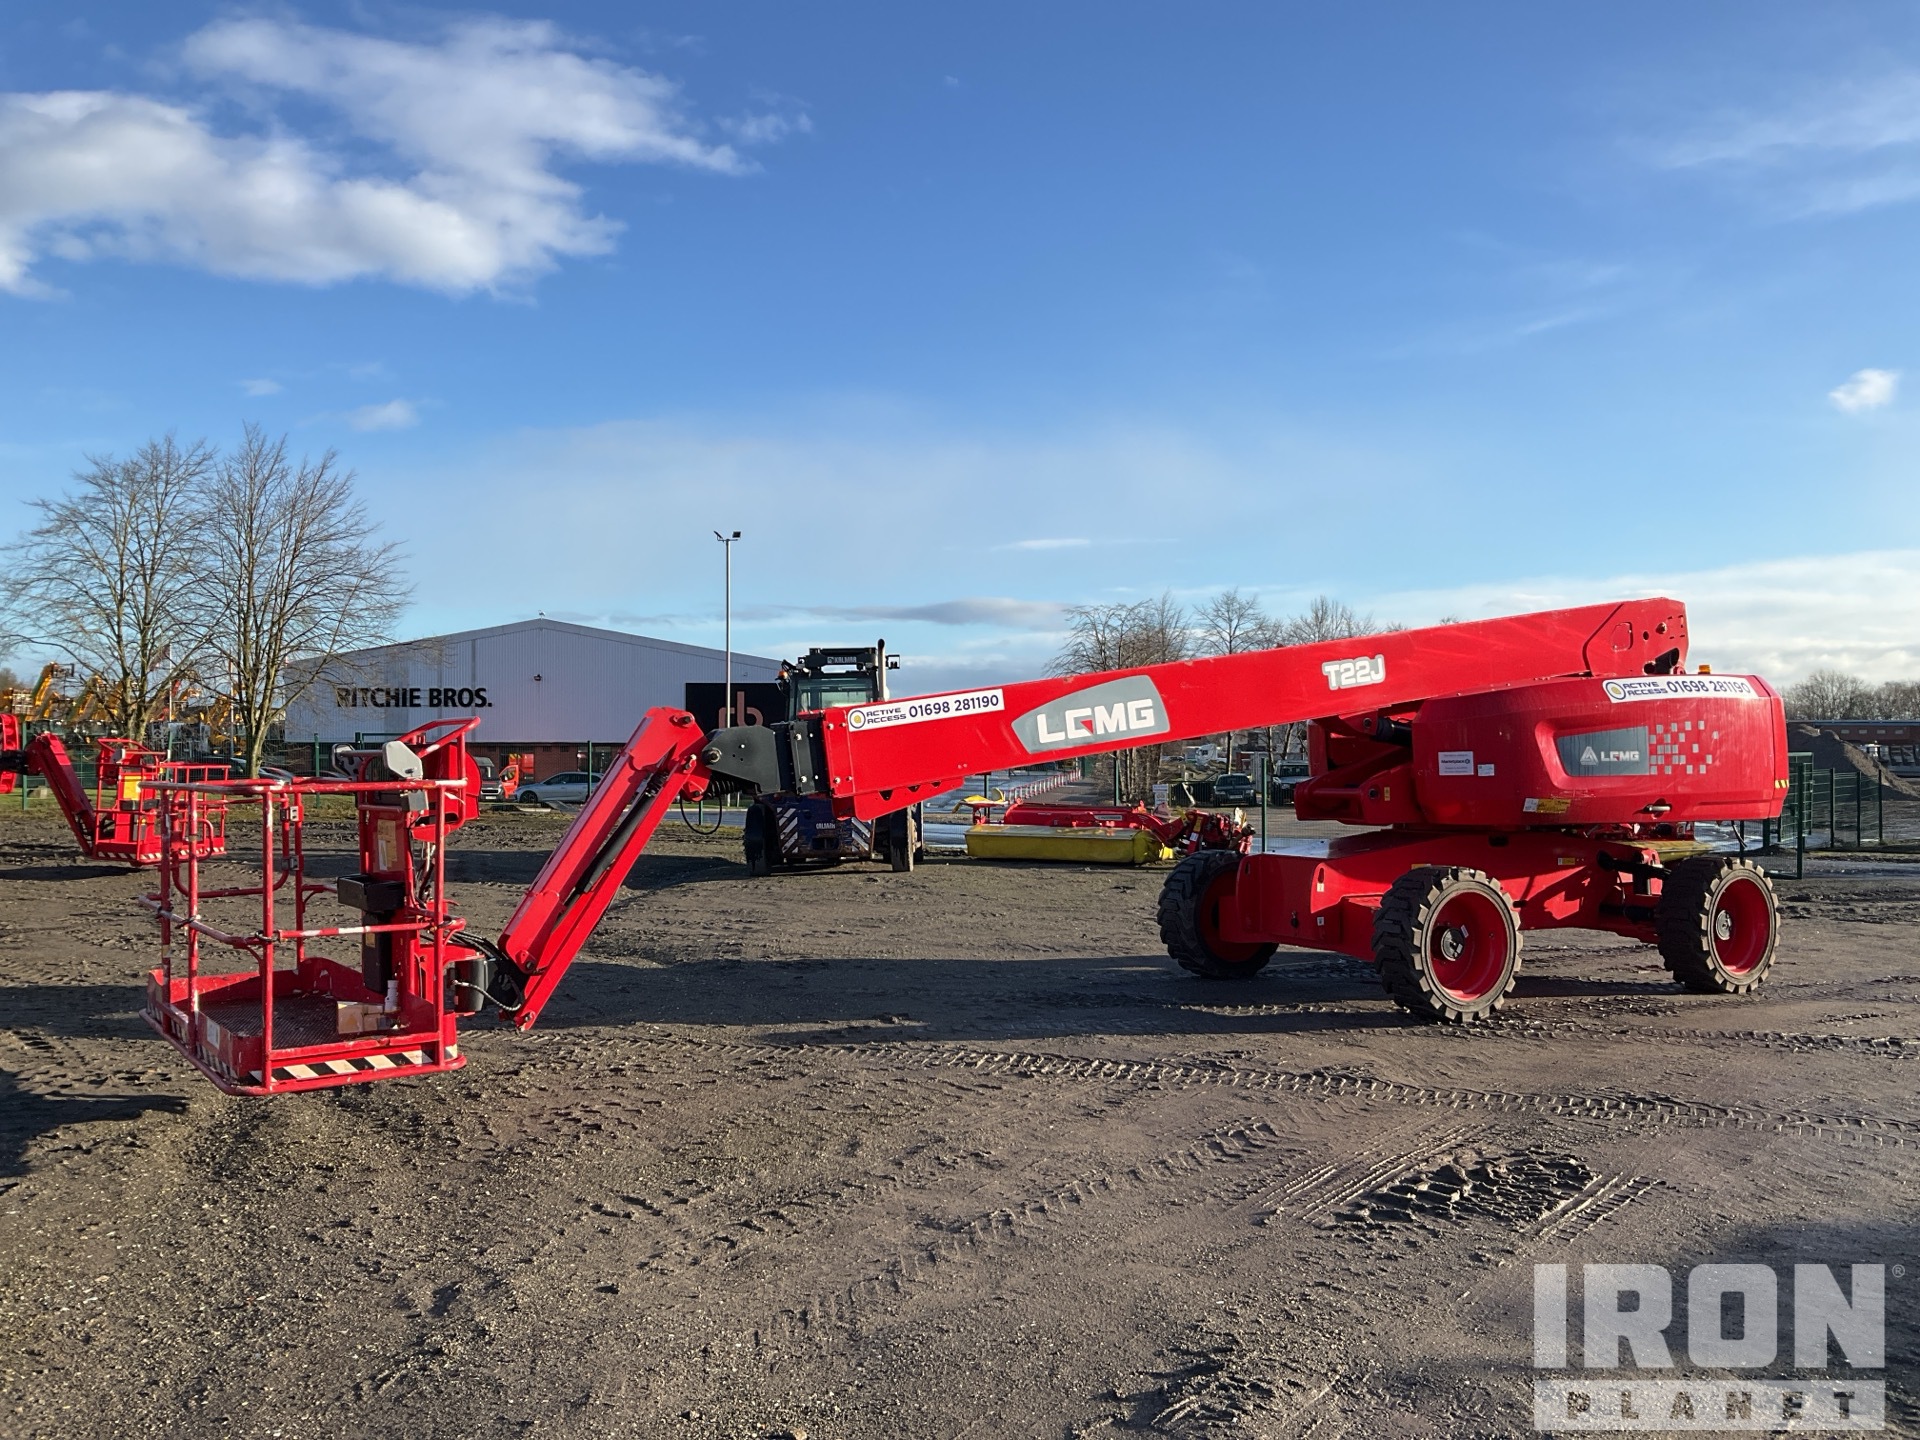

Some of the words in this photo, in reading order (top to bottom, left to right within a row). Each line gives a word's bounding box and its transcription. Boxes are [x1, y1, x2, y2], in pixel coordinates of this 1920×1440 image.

[1323, 656, 1385, 689] T22J
[1623, 681, 1659, 689] ACTIVE
[1626, 687, 1668, 696] ACCESS
[1666, 680, 1708, 693] 01698
[1709, 680, 1751, 694] 281190
[336, 687, 422, 708] RITCHIE
[428, 687, 493, 708] BROS.
[866, 707, 902, 717] ACTIVE
[908, 701, 950, 718] 01698
[954, 694, 999, 712] 281190
[866, 713, 907, 725] ACCESS
[1036, 698, 1155, 744] LCMG
[1600, 751, 1639, 762] LCMG
